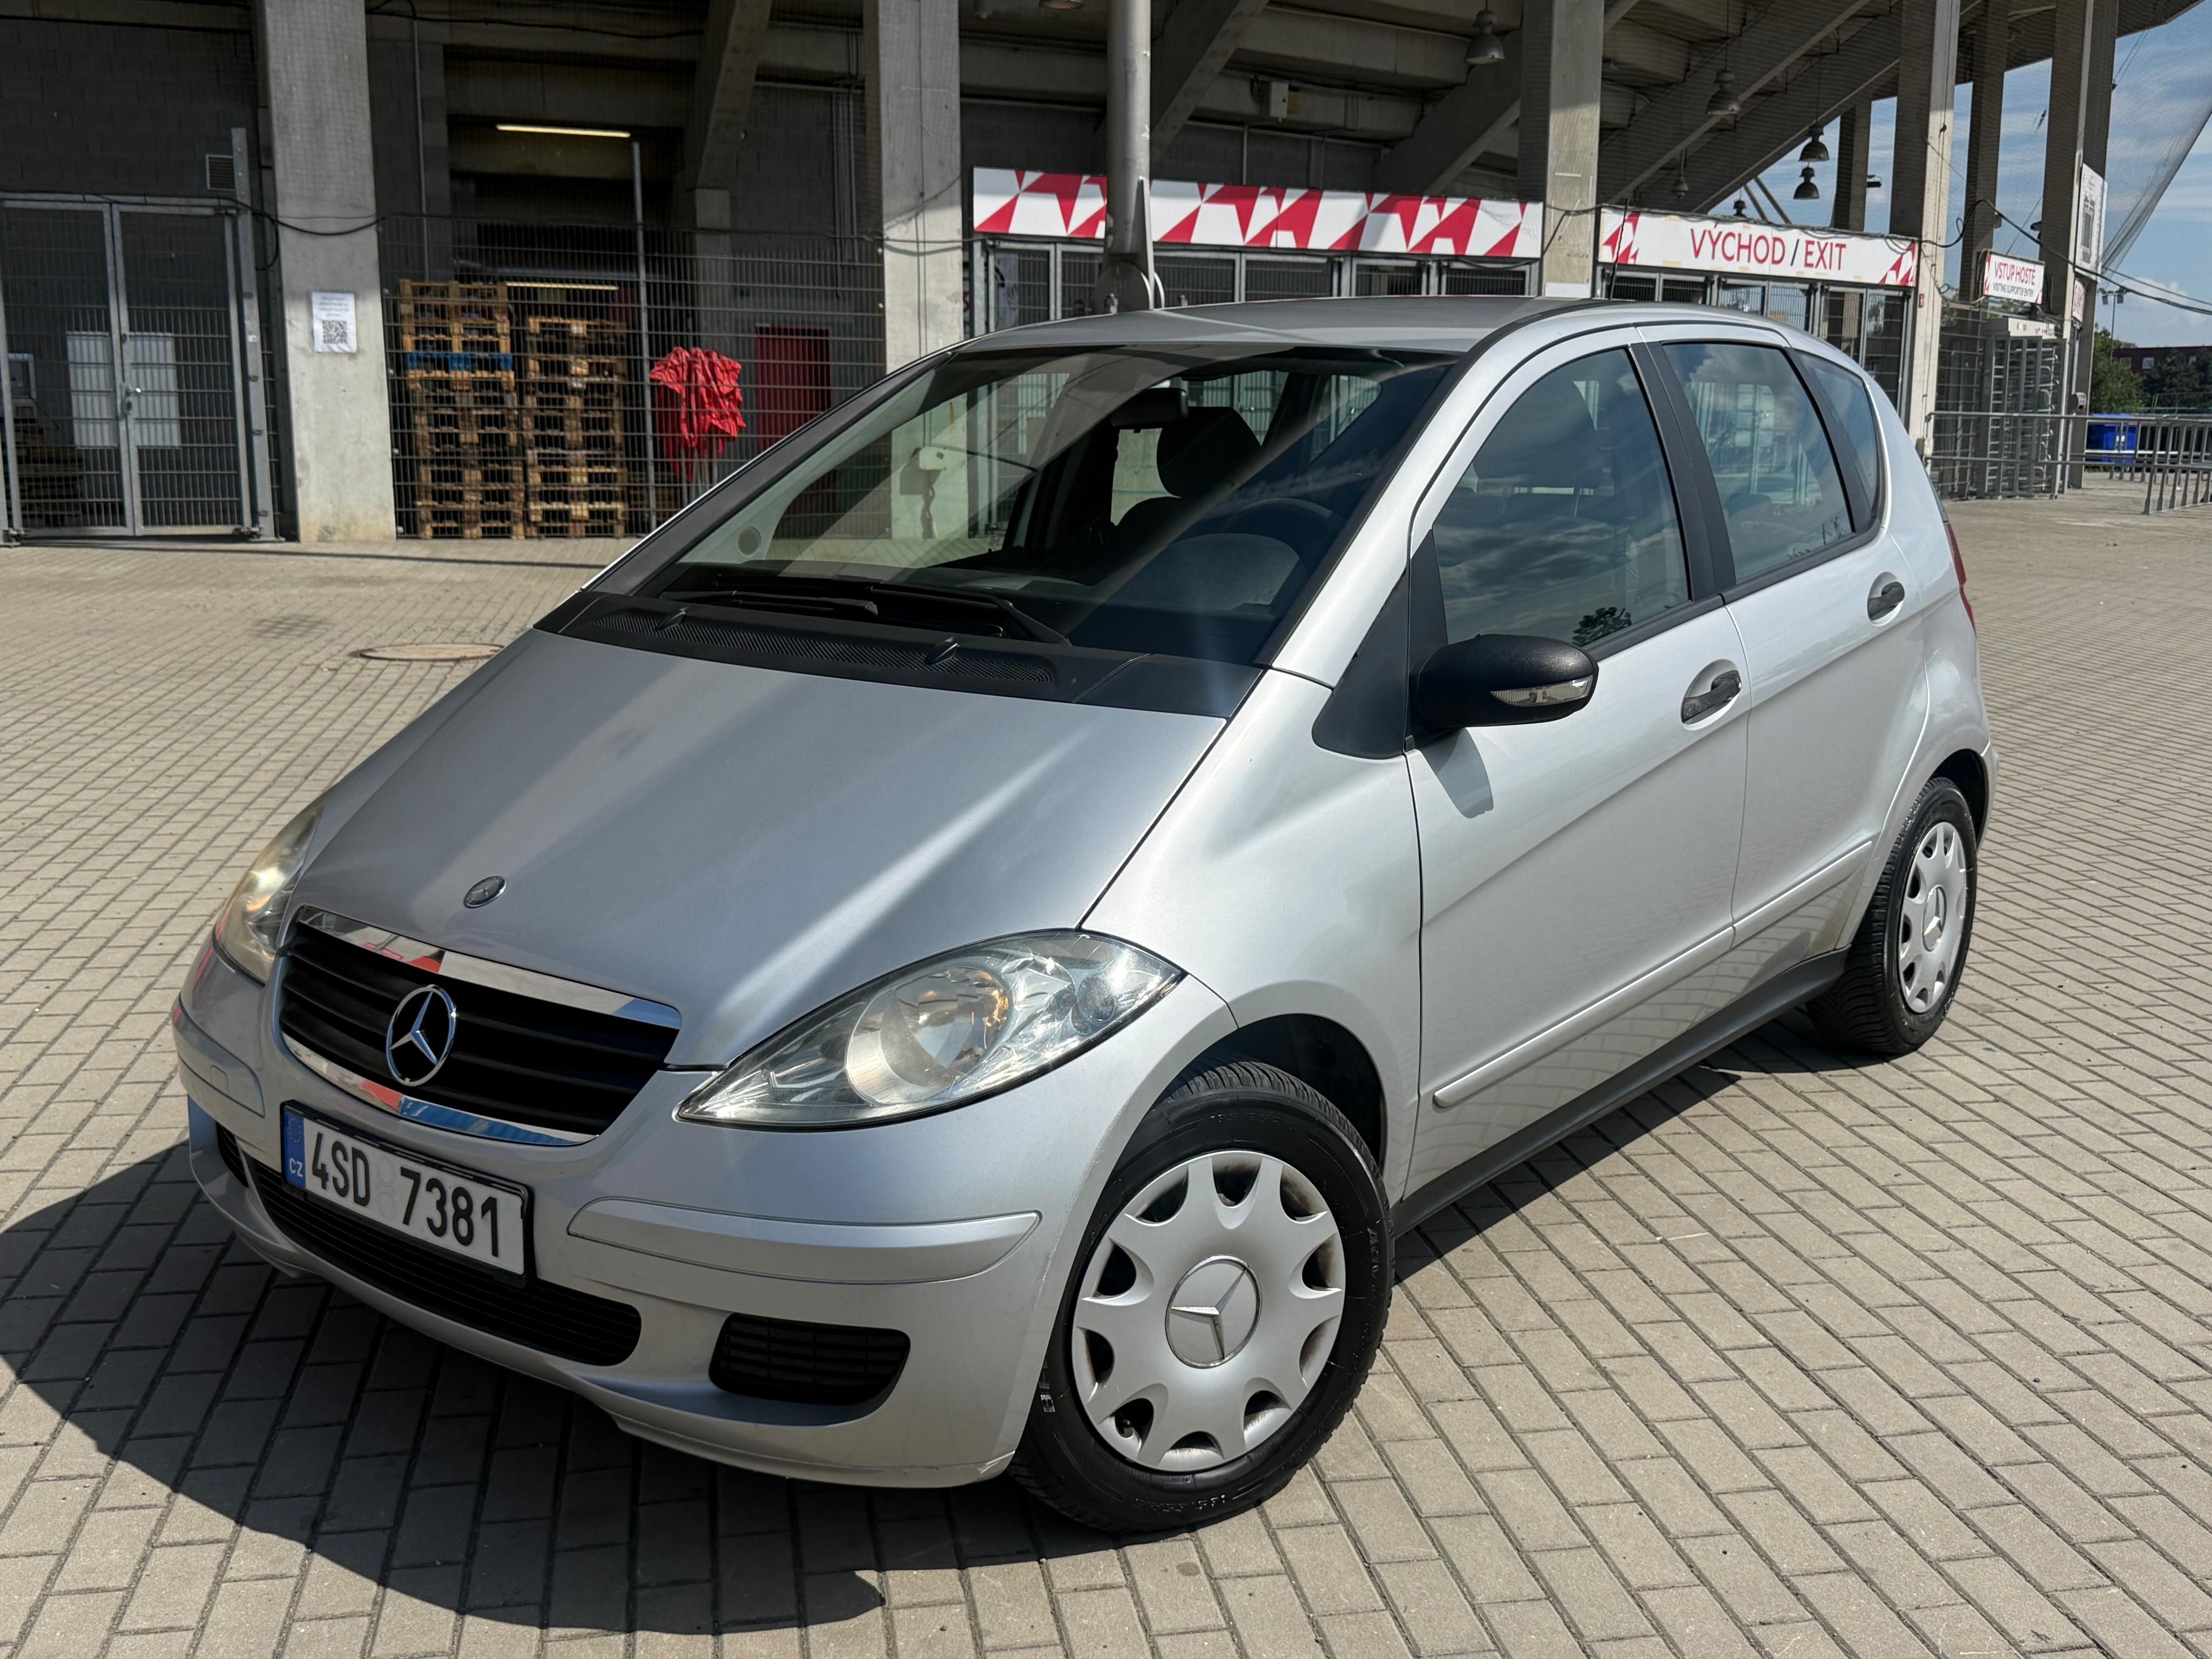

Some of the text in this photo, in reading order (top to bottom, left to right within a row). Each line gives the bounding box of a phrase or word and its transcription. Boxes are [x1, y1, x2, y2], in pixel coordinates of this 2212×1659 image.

[1690, 222, 1846, 270] VÝCHOD / EXIT
[1995, 261, 2015, 280] VSTUP
[1993, 282, 2006, 293] VISITING
[289, 1157, 304, 1178] CZ
[312, 1132, 499, 1258] 4SD 7381
